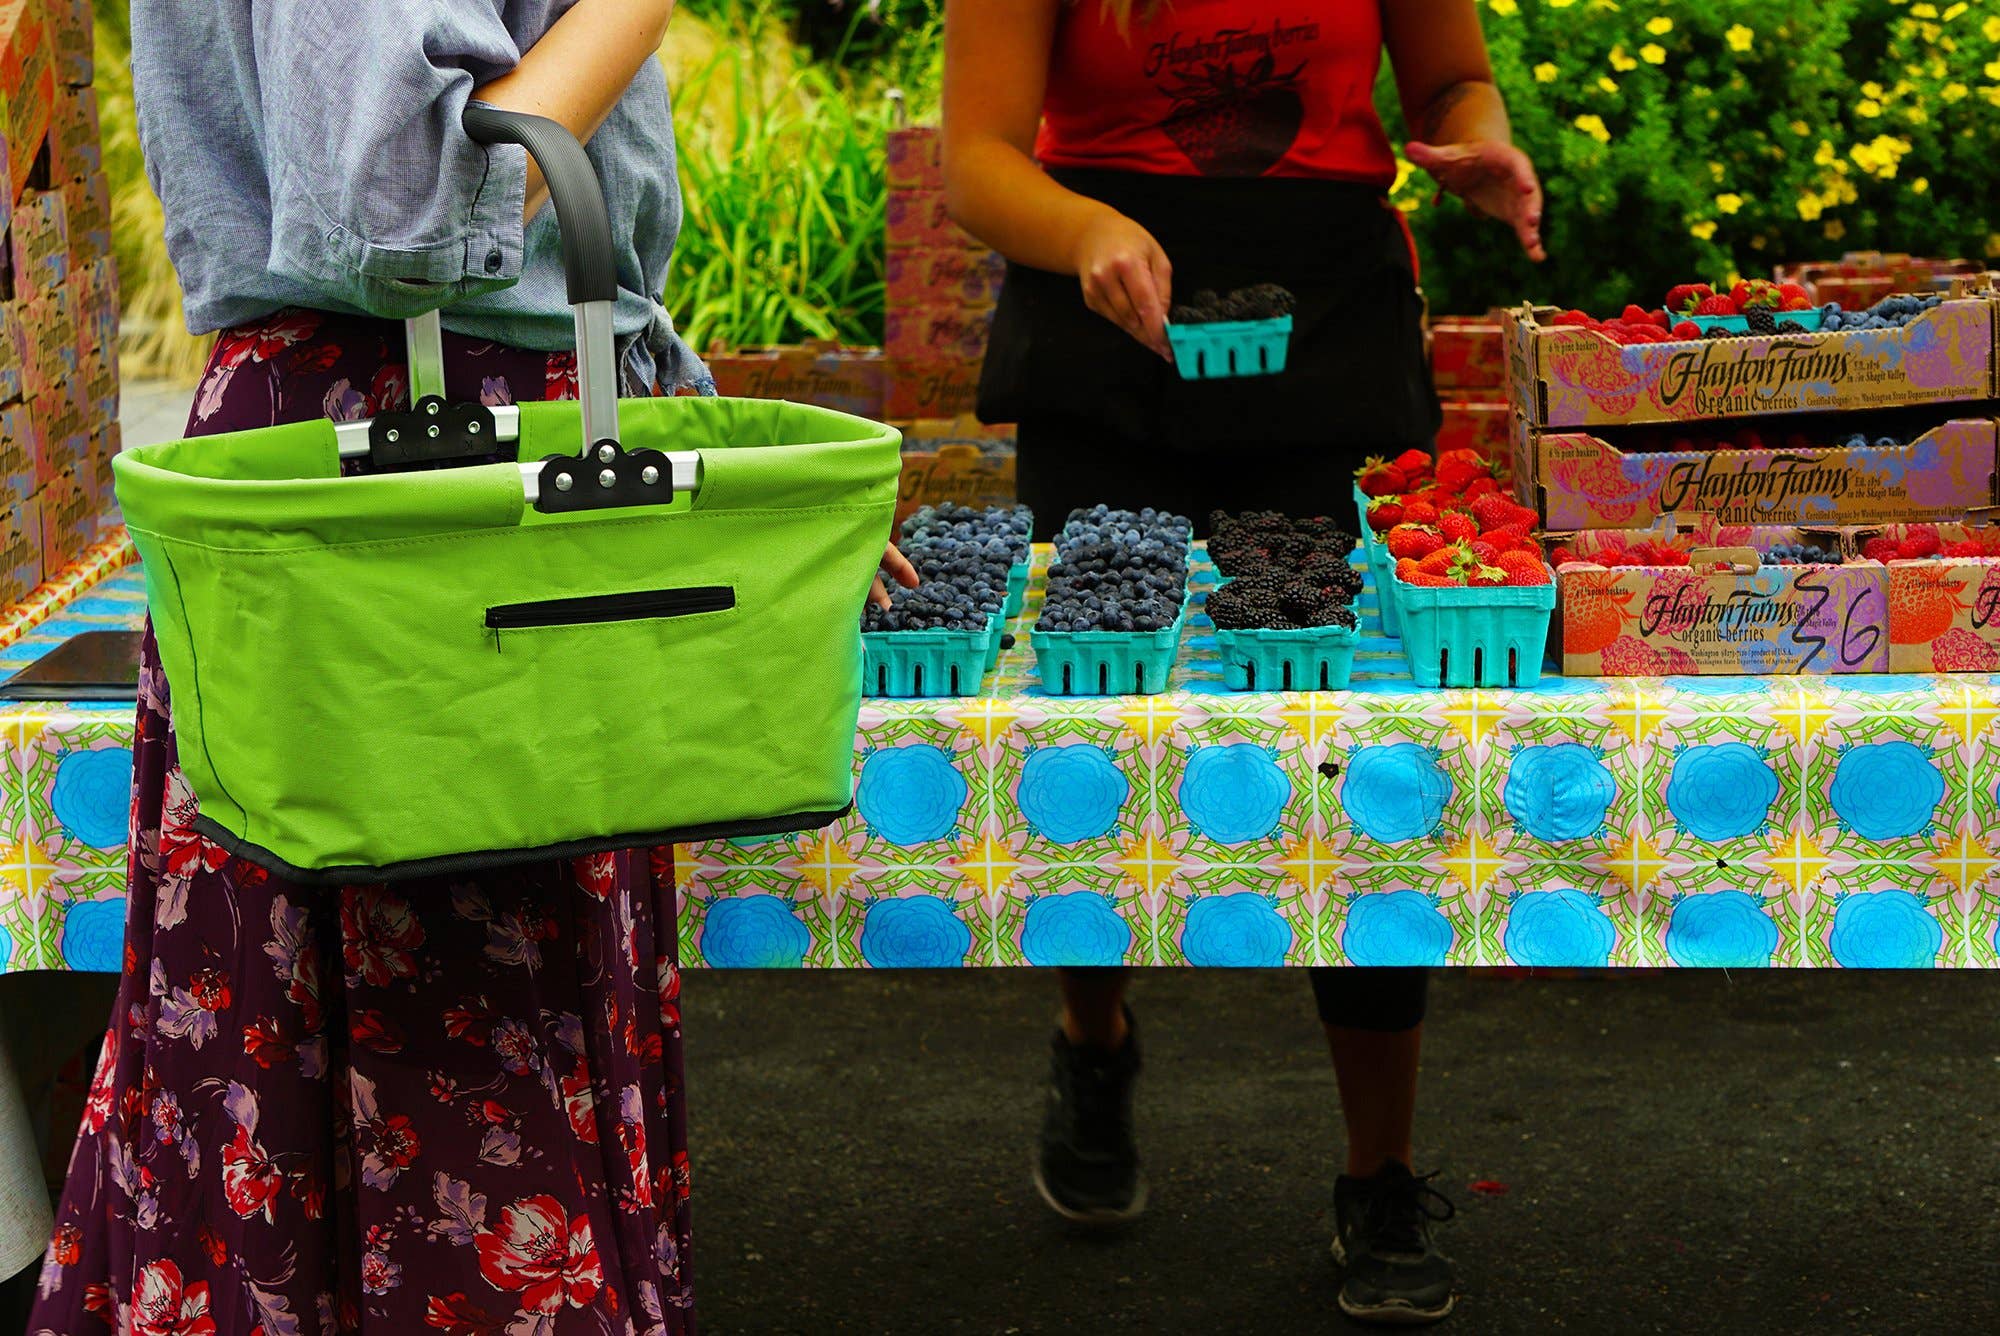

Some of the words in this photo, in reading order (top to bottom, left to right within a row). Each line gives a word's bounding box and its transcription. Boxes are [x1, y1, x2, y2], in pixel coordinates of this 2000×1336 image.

[1660, 340, 1776, 406] Hayton
[1767, 337, 1852, 399] Farms
[1696, 387, 1758, 419] Organic
[1761, 393, 1798, 412] berries
[1660, 452, 1776, 512] Hayton
[1767, 453, 1852, 513] Farms
[1866, 486, 1886, 500] Skagit
[1888, 486, 1906, 499] Valley
[1761, 505, 1798, 523] berries
[1639, 584, 1734, 638] Hayton
[1728, 584, 1797, 630] Farms
[1682, 623, 1721, 649] organic
[1726, 623, 1765, 642] berries
